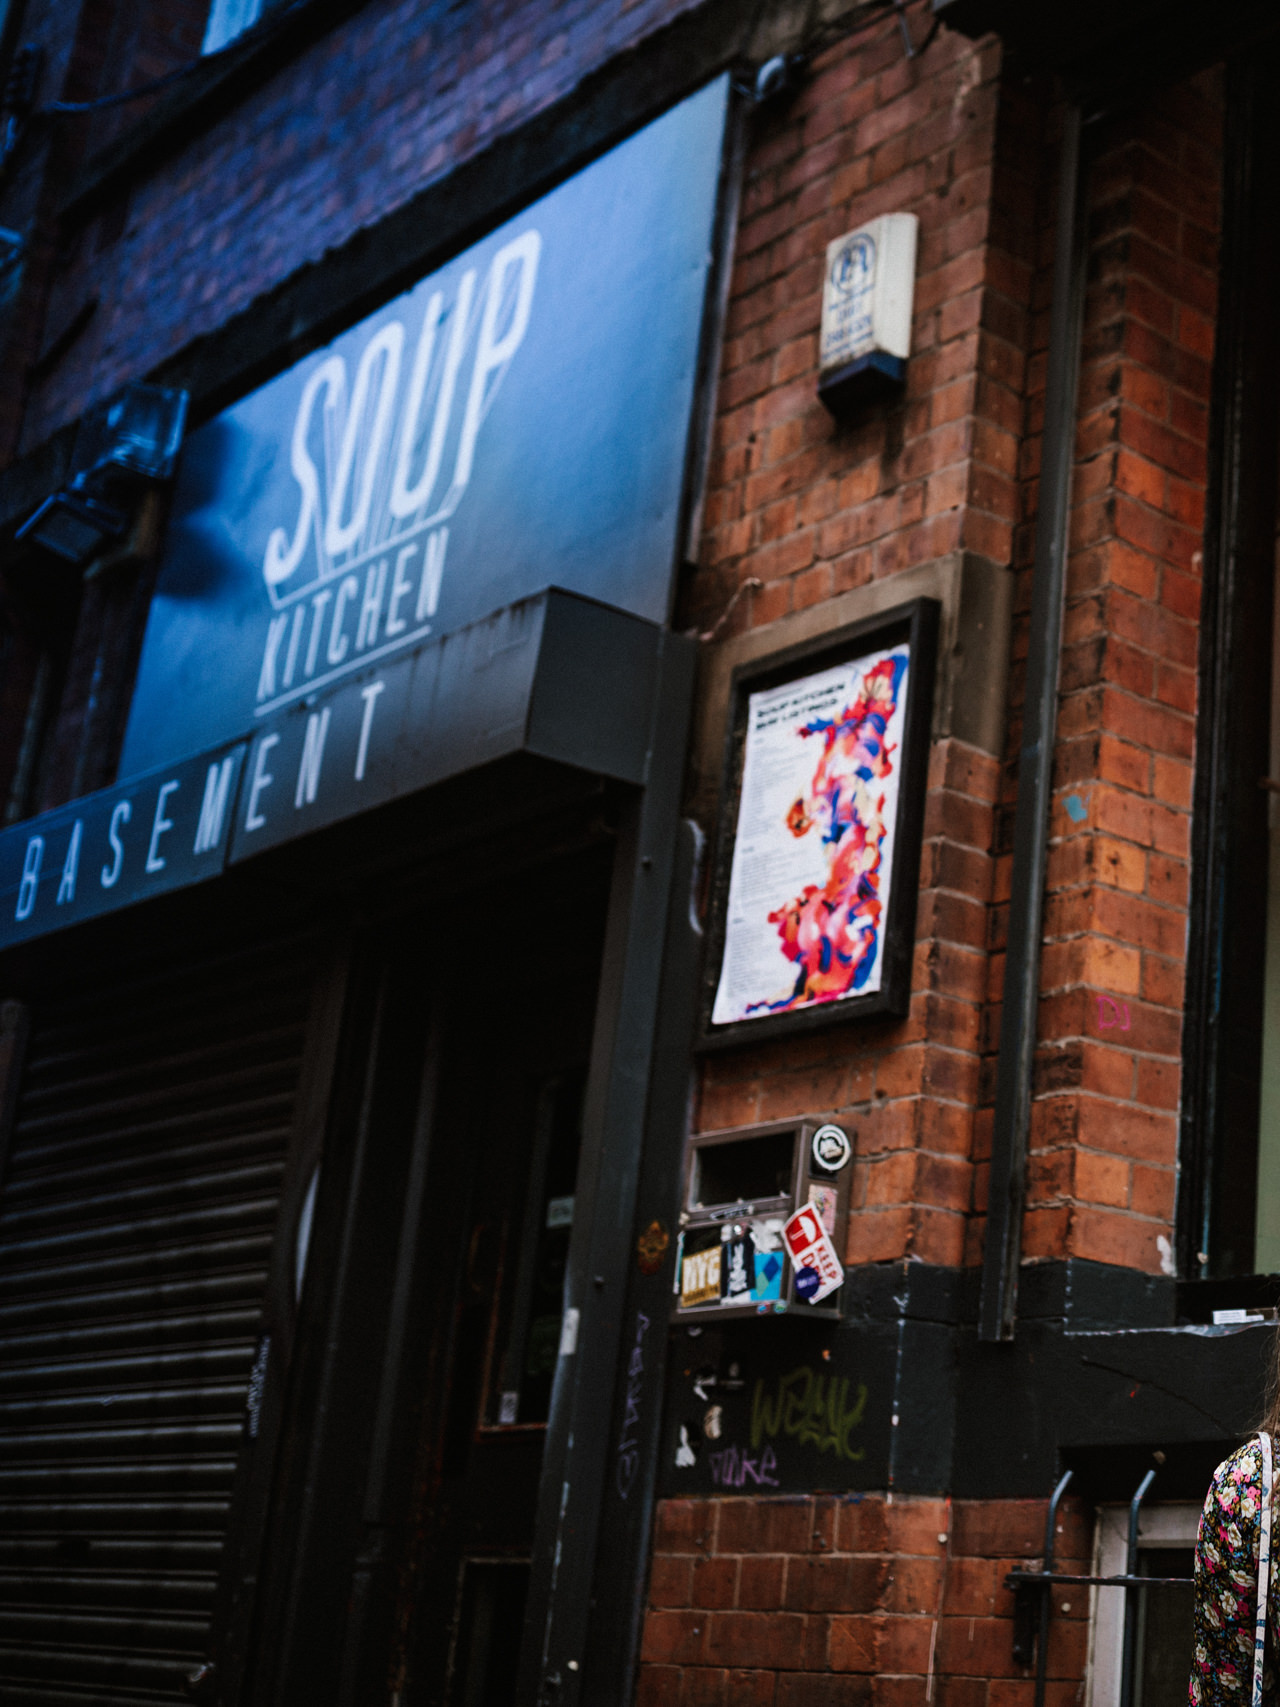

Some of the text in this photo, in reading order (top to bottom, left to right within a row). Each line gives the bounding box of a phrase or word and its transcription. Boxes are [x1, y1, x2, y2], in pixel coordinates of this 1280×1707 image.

[264, 229, 542, 583] SOUP
[257, 528, 449, 700] KITCHEN
[14, 681, 385, 921] BASEMENT
[815, 1245, 838, 1280] KEEP
